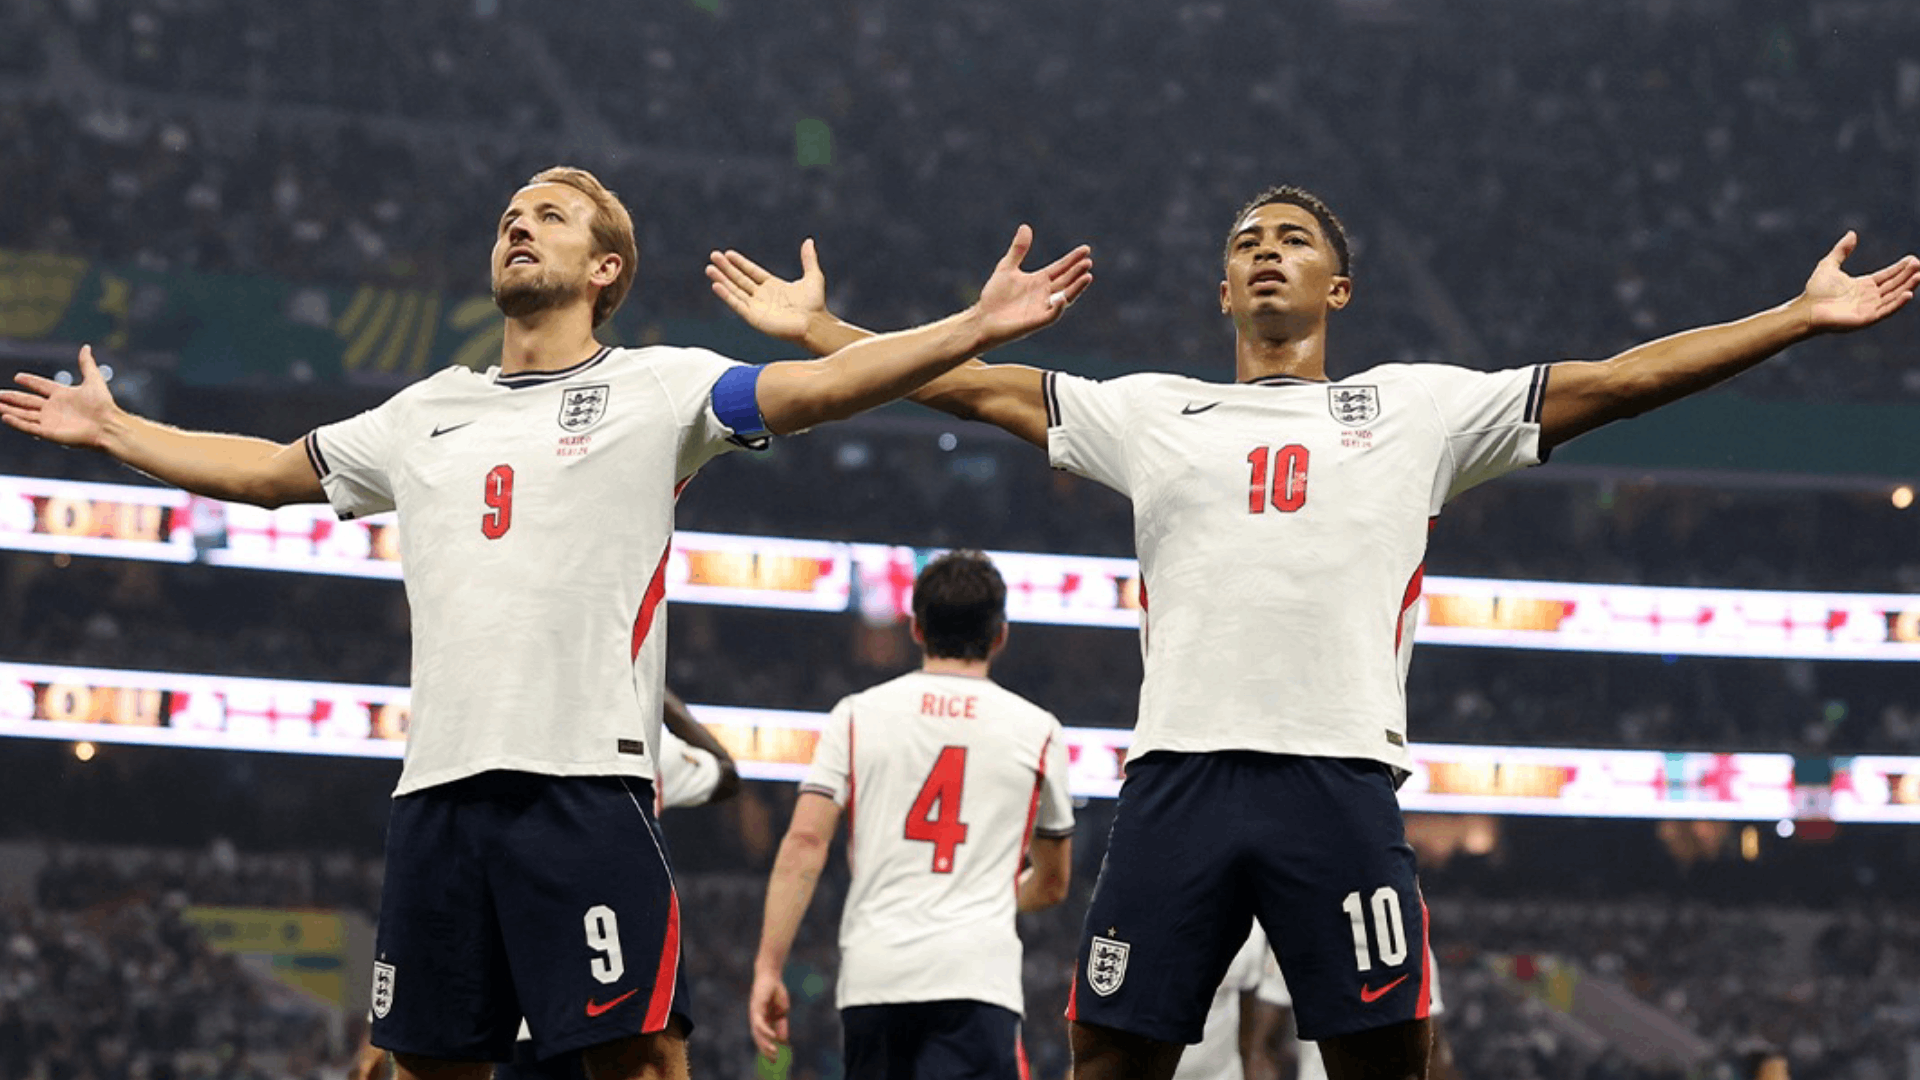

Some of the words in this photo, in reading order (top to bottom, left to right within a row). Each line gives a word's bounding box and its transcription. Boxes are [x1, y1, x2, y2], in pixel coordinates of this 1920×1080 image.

[481, 464, 515, 540] 9
[1247, 443, 1310, 514] 10
[920, 692, 979, 719] RICE
[904, 745, 969, 874] 4
[583, 905, 625, 984] 9
[1342, 886, 1408, 972] 10
